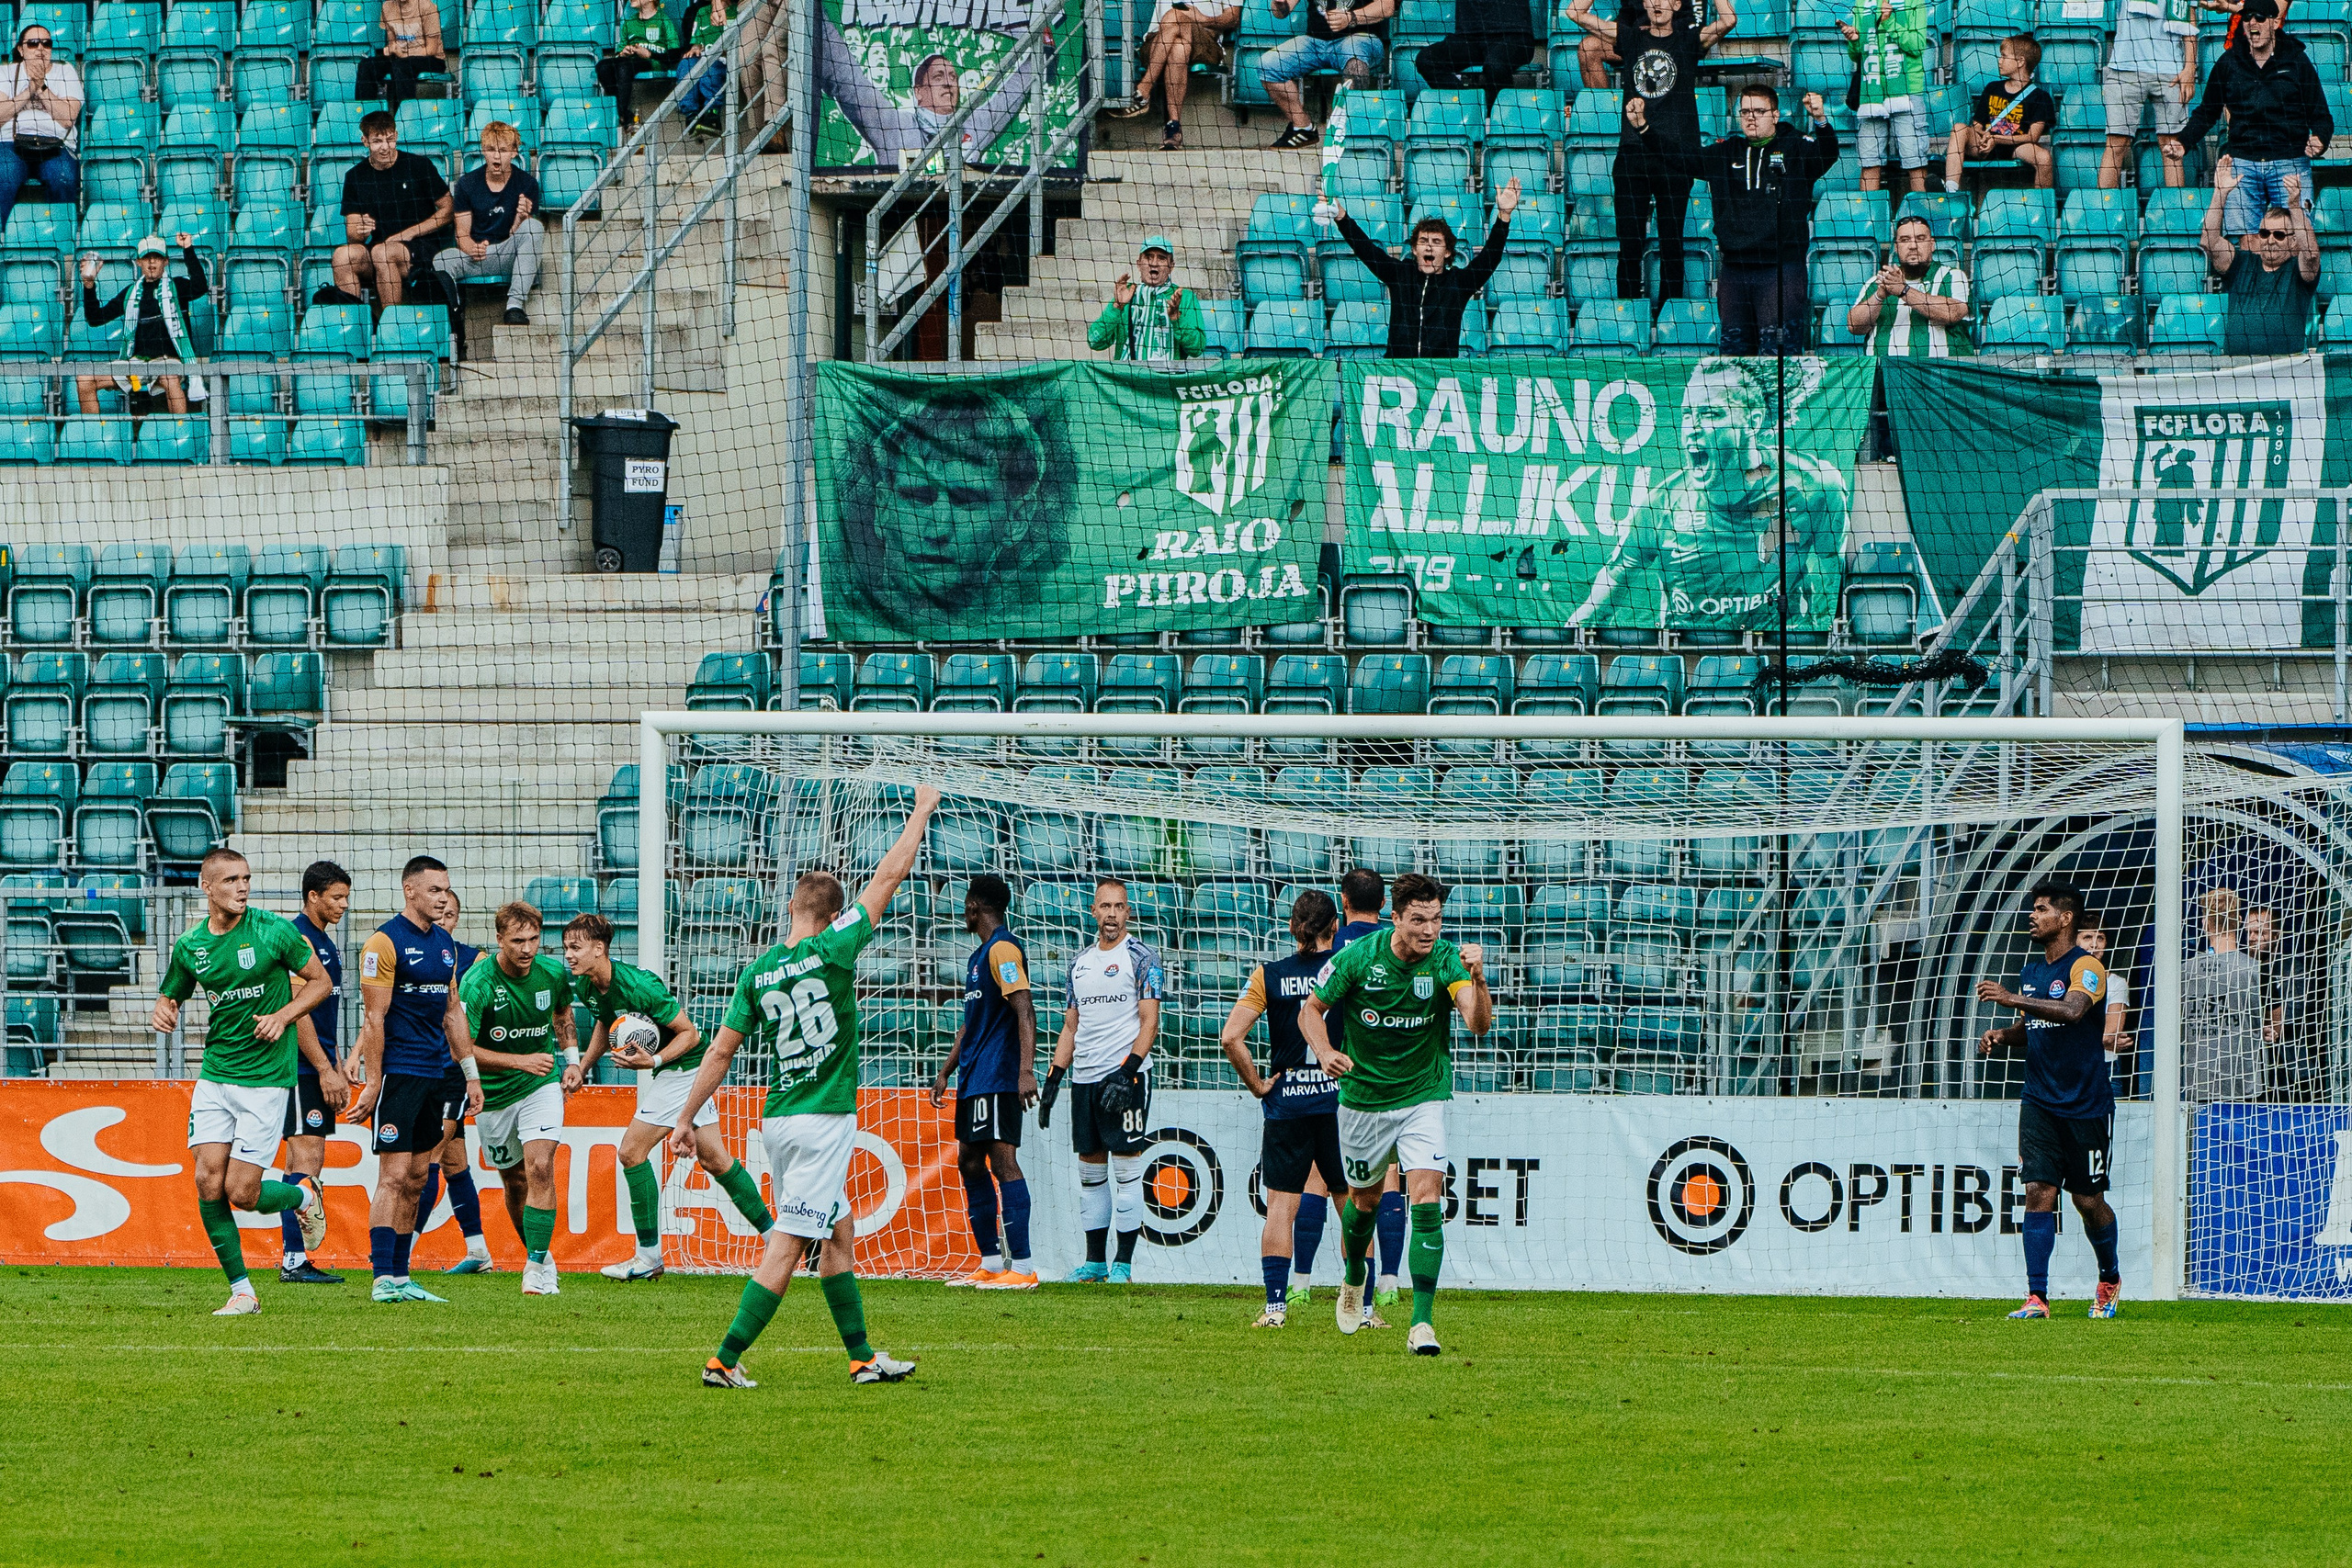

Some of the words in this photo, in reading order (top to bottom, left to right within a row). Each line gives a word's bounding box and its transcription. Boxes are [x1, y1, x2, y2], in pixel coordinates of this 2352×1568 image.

[1362, 375, 1657, 454] RAUNO
[2143, 412, 2270, 436] FCFLORA
[631, 465, 660, 474] PYRO
[631, 479, 659, 487] FUND
[1368, 459, 1653, 536] ALLIKU
[1149, 517, 1282, 561] RAIO
[1103, 563, 1310, 609] PIIROJA
[220, 983, 266, 1001] OPTIBET
[1080, 993, 1128, 1007] SPORTLAND
[509, 1022, 549, 1039] OPTIBET
[760, 977, 840, 1060] 26
[1282, 1084, 1319, 1098] NARVA
[972, 1097, 989, 1123] 10
[1122, 1109, 1144, 1134] 88
[487, 1145, 514, 1165] 22
[2088, 1149, 2105, 1177] 12
[1345, 1156, 1372, 1182] 28
[1780, 1161, 2064, 1235] OPTIBE
[1274, 1289, 1282, 1298] 7
